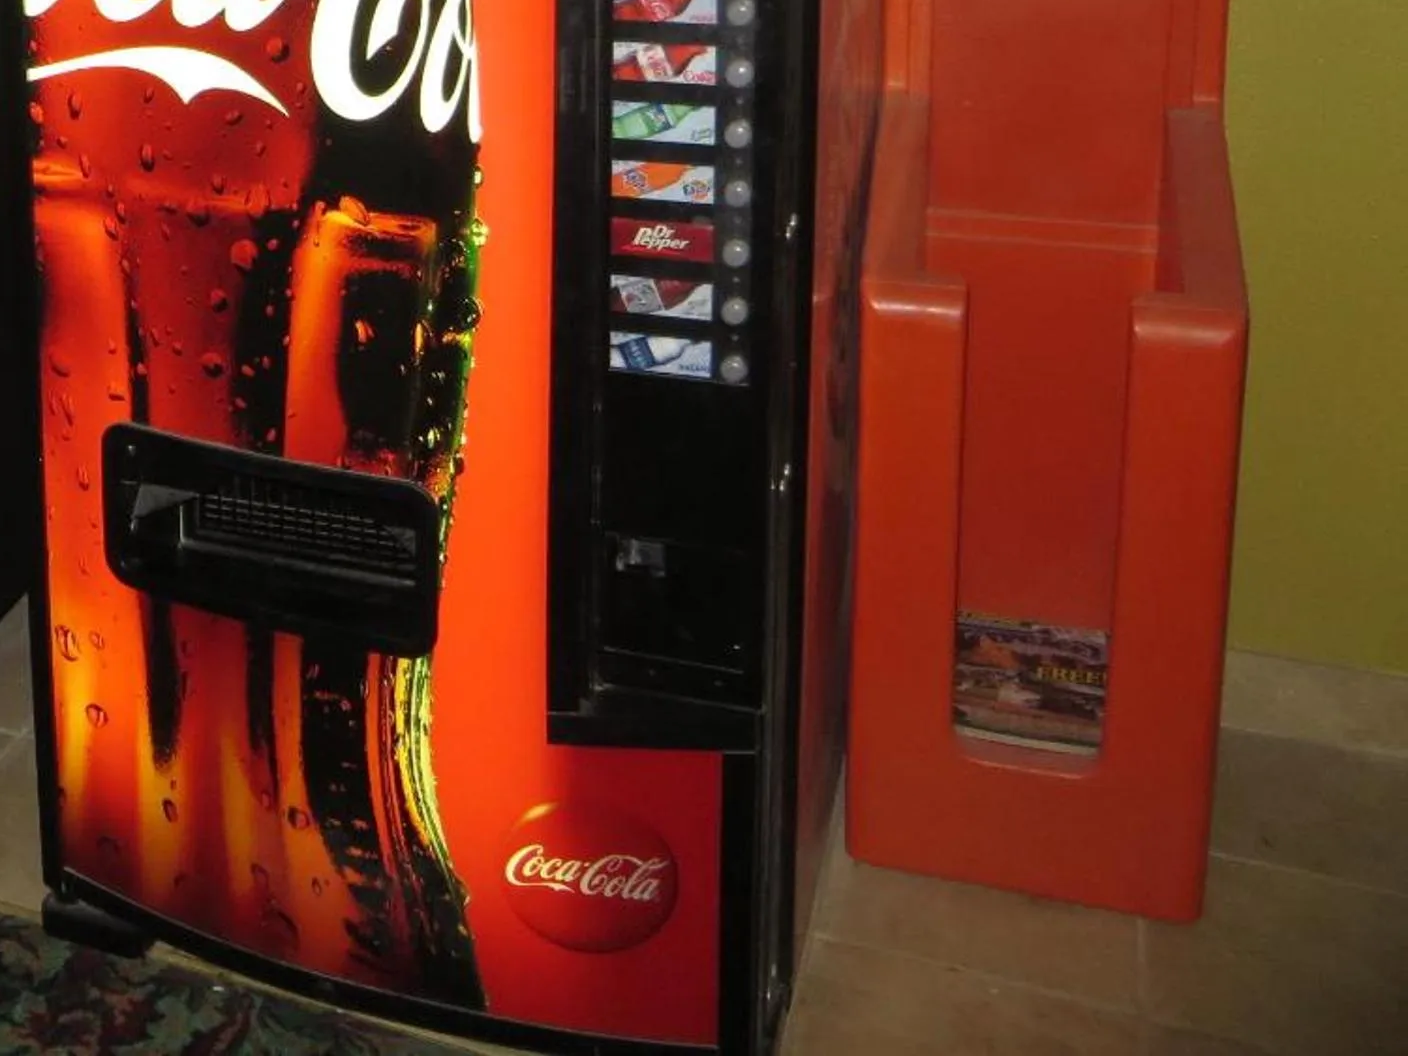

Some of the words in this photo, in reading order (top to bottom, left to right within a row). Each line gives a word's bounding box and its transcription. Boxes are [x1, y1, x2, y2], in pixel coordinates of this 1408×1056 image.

[632, 226, 691, 252] Pepper
[649, 224, 677, 239] Dr
[504, 843, 670, 901] Coca-Cola
